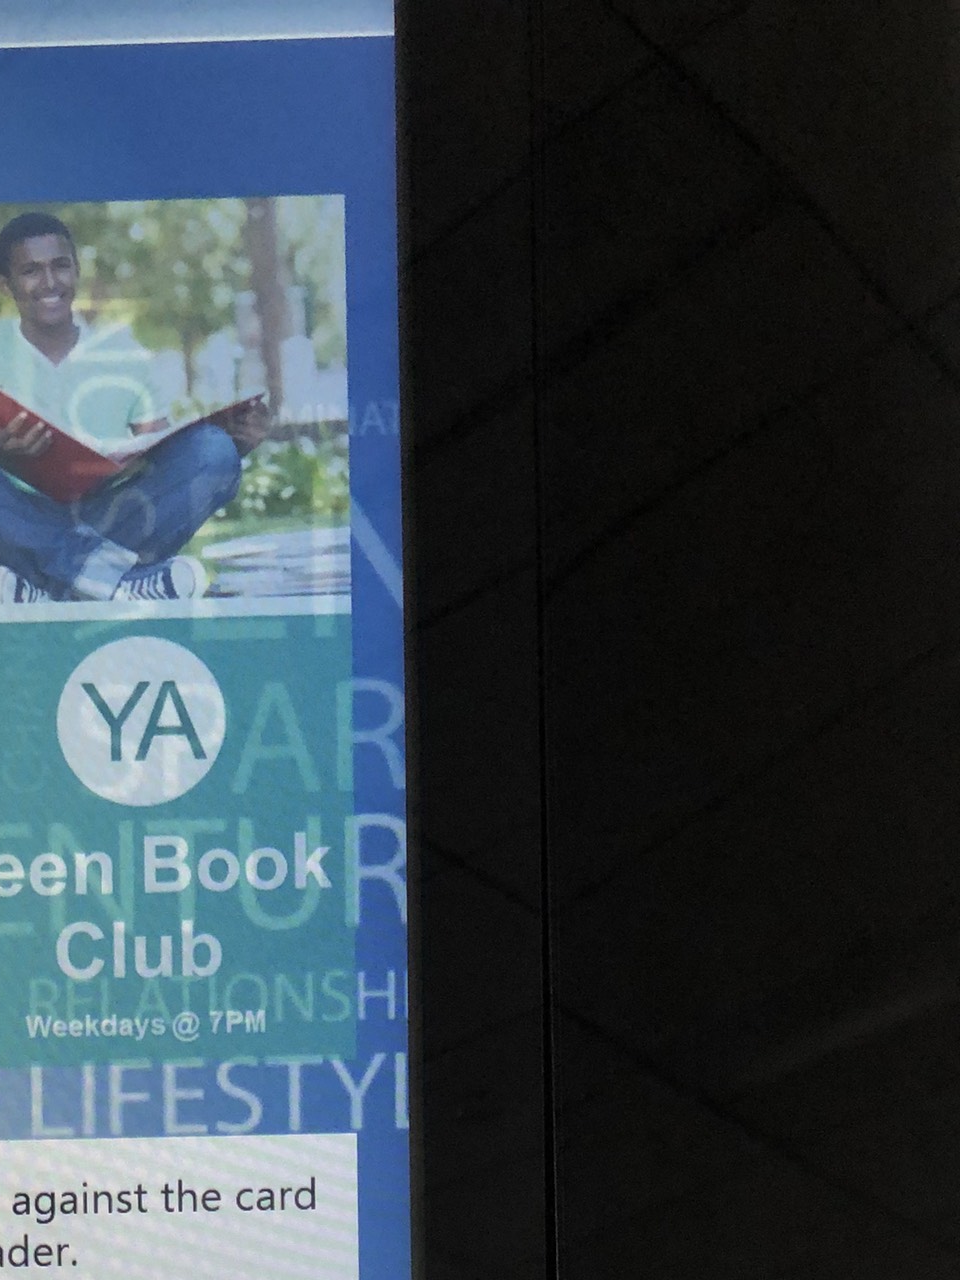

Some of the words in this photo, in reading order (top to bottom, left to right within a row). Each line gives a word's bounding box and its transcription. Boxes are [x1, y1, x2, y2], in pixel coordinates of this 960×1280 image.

[81, 680, 207, 762] YA
[143, 832, 333, 894] Book
[56, 919, 224, 980] Club
[25, 1012, 167, 1041] Weekdays
[172, 1012, 201, 1042] @
[209, 1010, 267, 1035] 7PM
[11, 1181, 149, 1225] against
[161, 1178, 223, 1214] the
[235, 1176, 319, 1213] card
